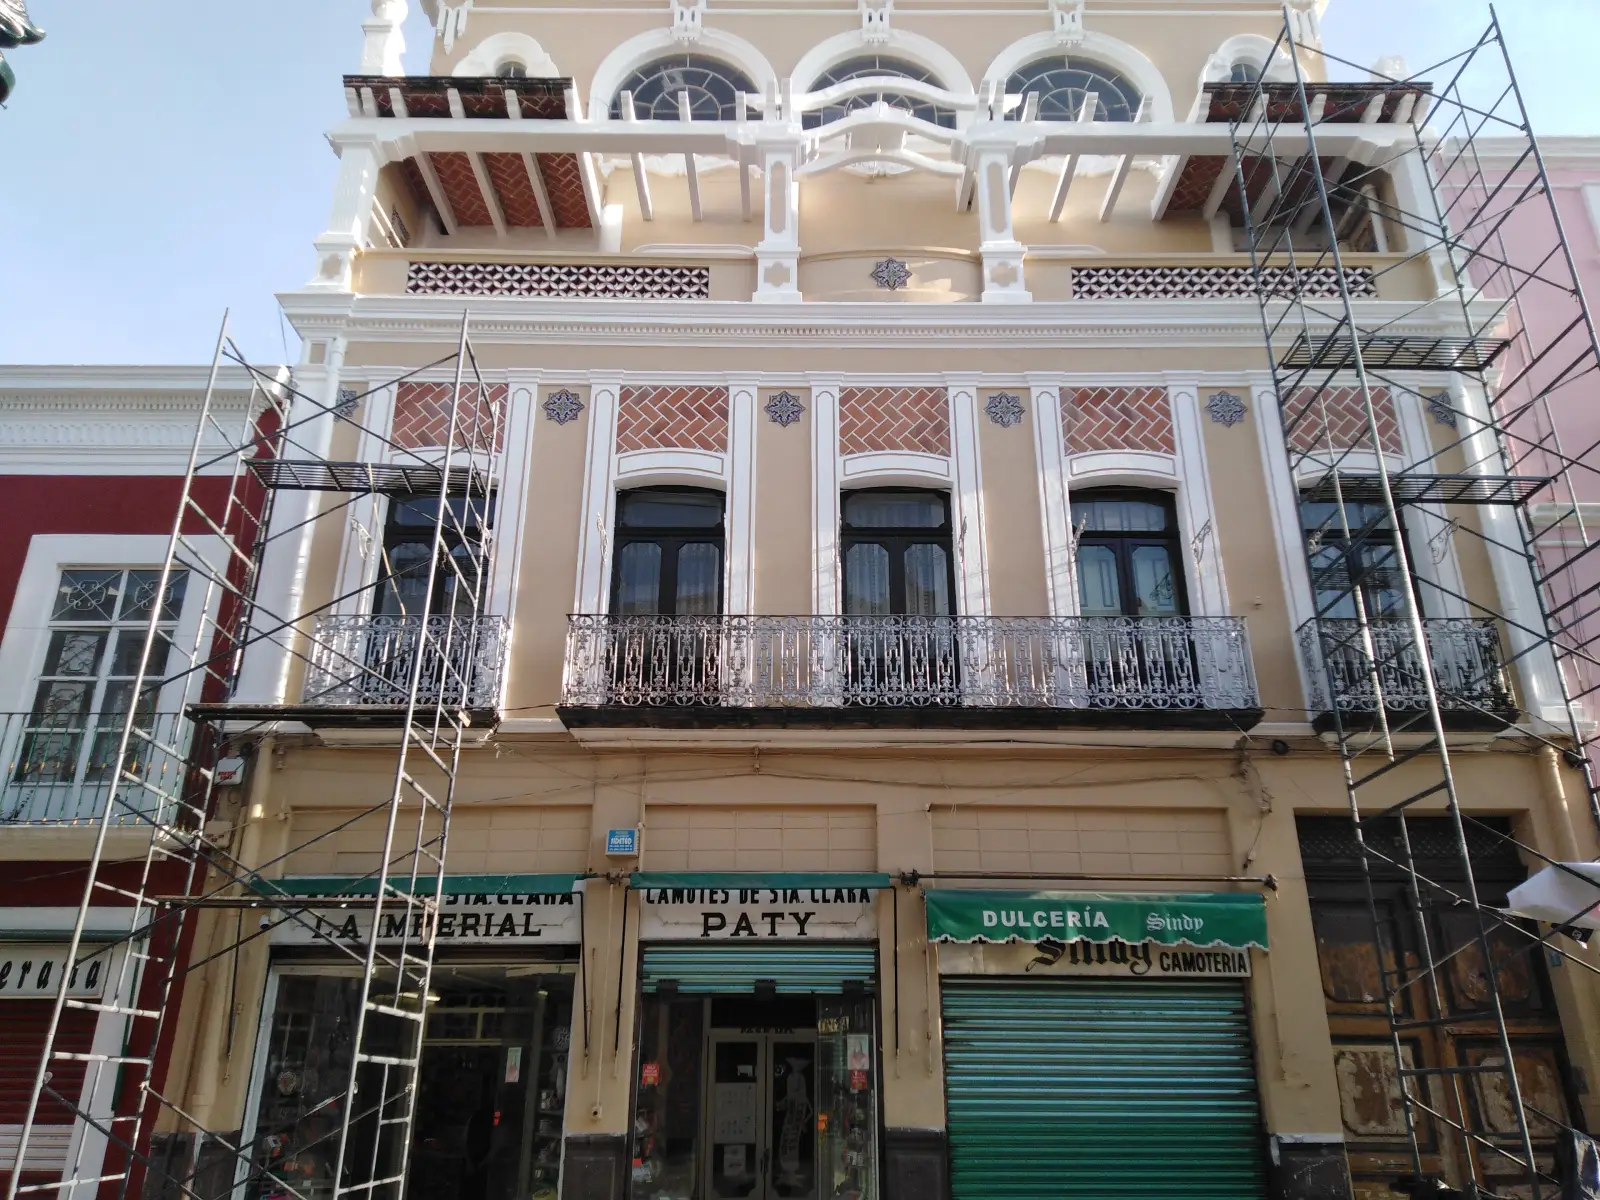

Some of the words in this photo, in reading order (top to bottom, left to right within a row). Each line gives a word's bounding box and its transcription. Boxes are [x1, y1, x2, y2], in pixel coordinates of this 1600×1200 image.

[739, 887, 760, 905] DE
[811, 887, 871, 904] CLARA
[312, 914, 362, 939] LA
[377, 912, 542, 938] IMPERIAL
[700, 911, 816, 937] PATY
[982, 906, 1110, 929] DULCERÍA
[1146, 912, 1205, 935] Sindy
[1159, 950, 1248, 974] CAMOTERIA
